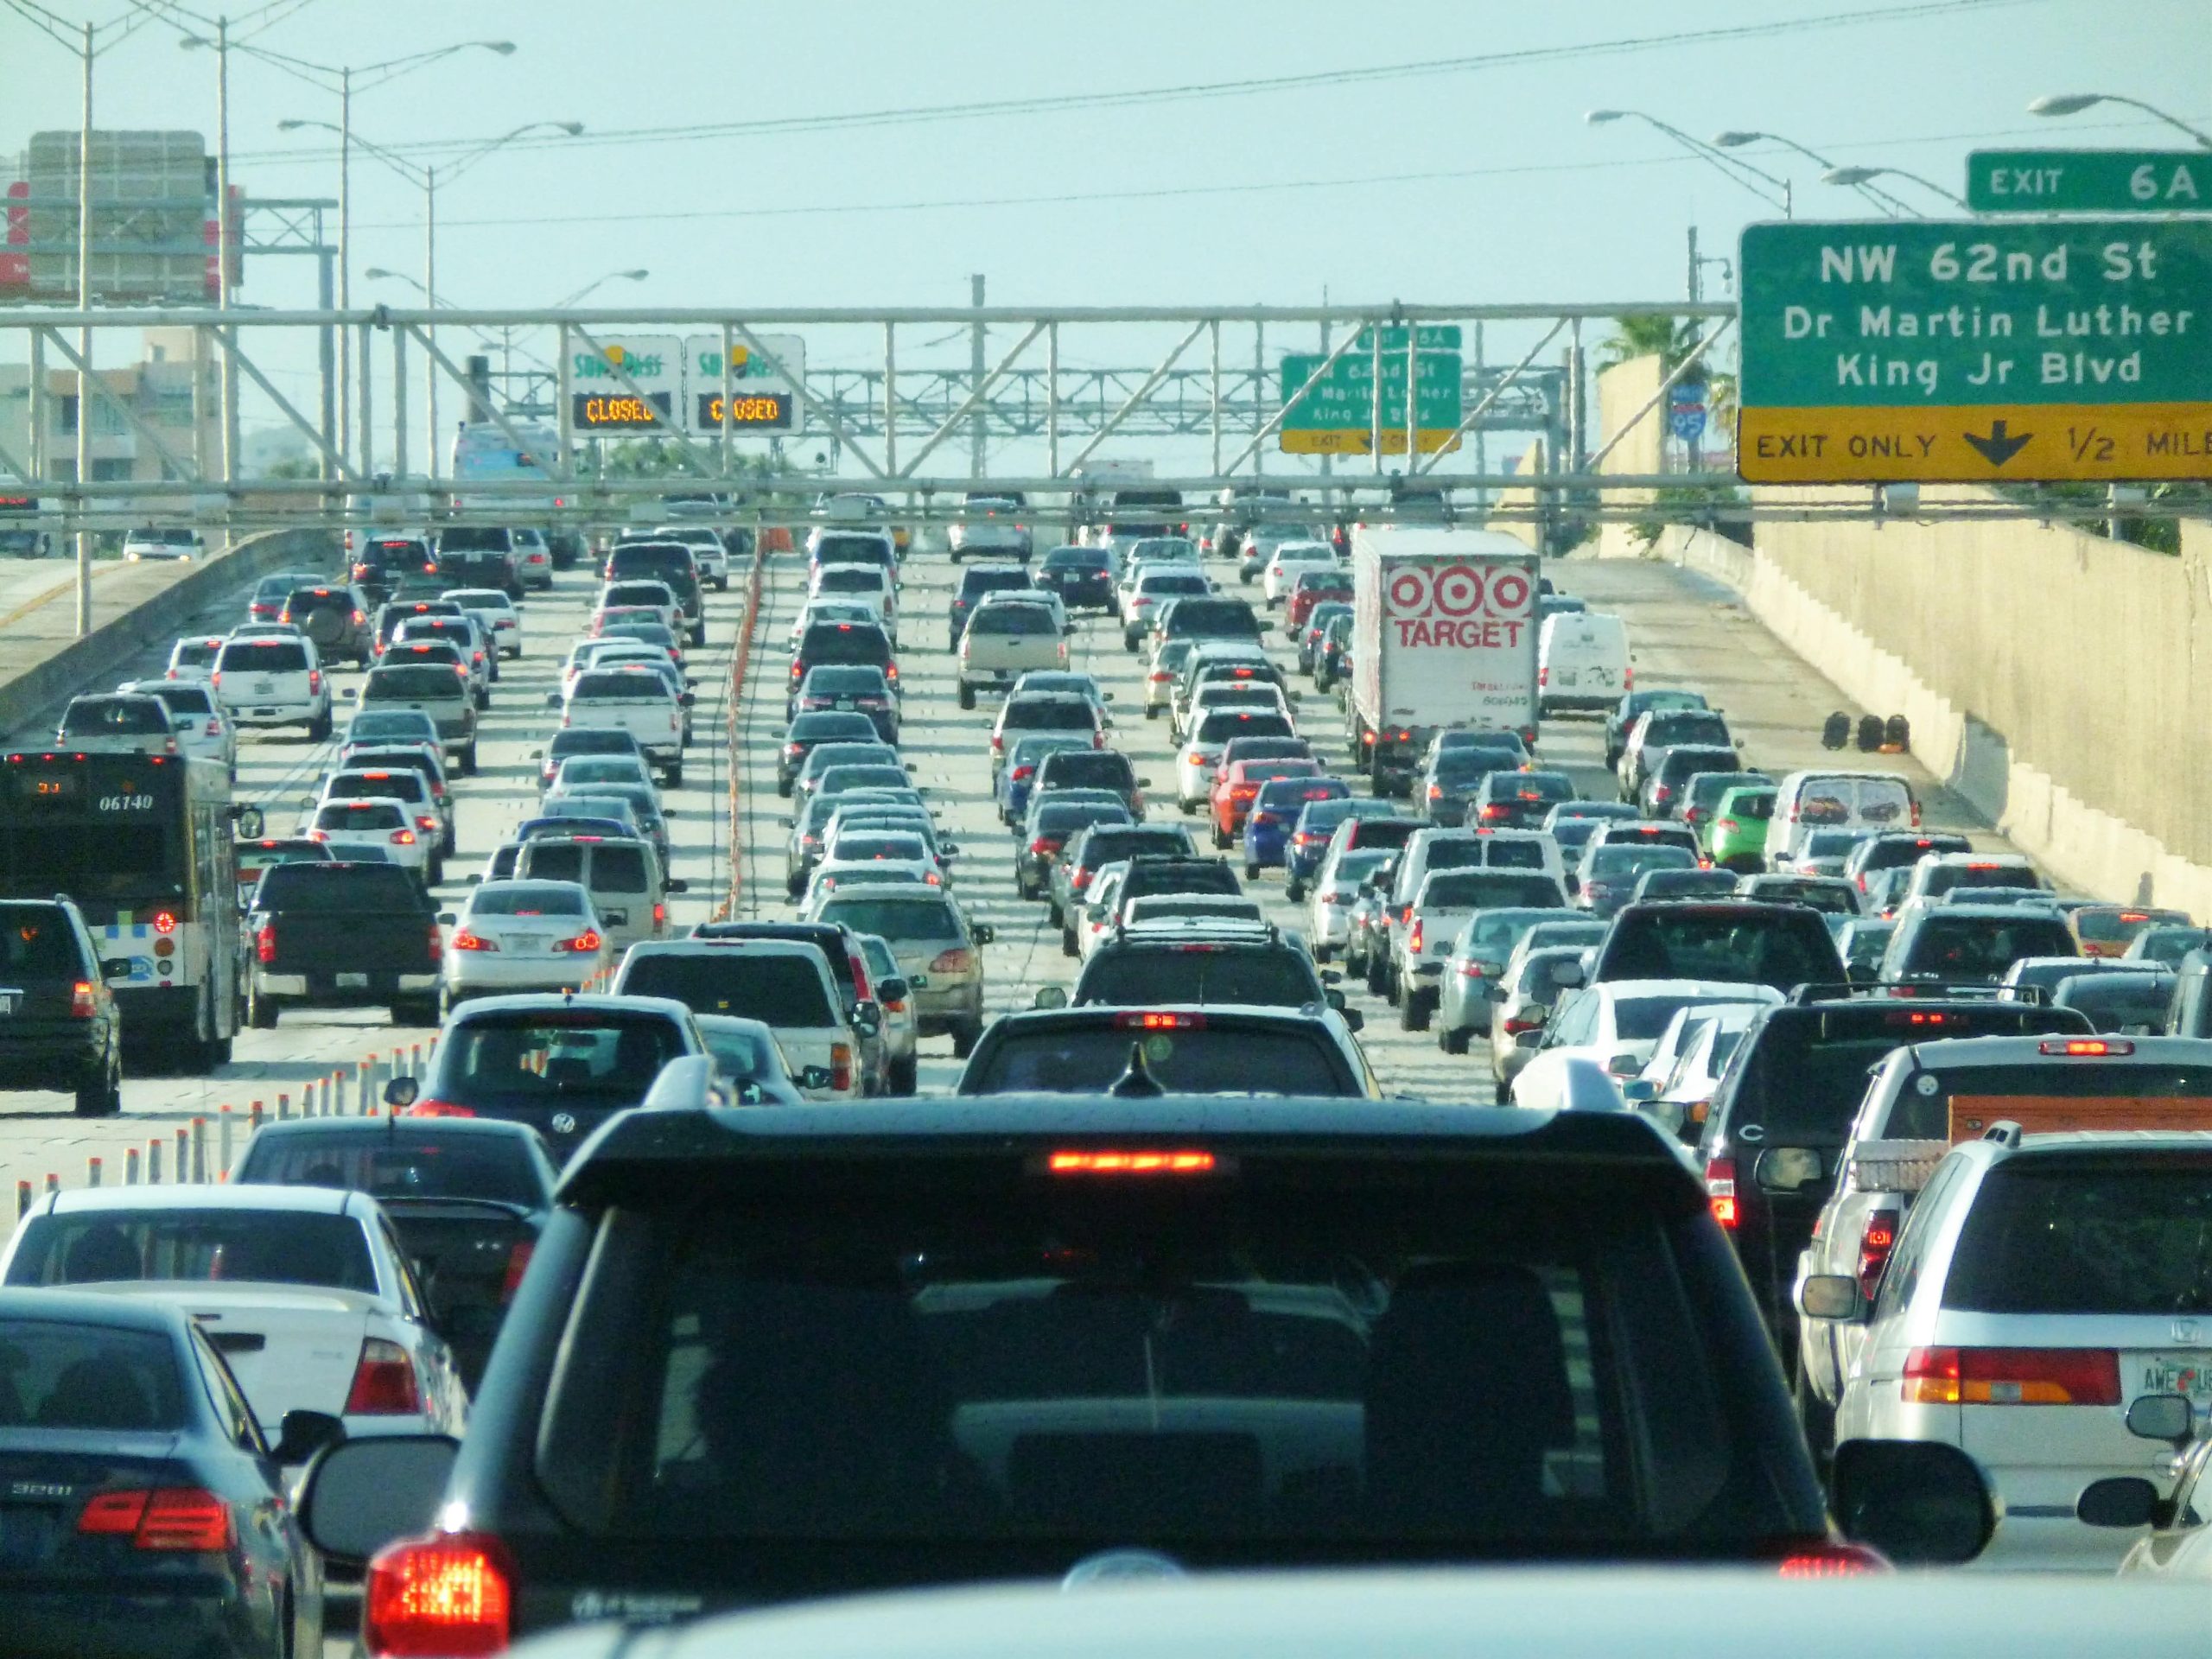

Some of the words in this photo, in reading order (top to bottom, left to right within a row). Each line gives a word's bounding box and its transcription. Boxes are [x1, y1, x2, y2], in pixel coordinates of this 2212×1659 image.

[1991, 168, 2063, 195] EXIT
[1821, 245, 1897, 283] NW
[1929, 243, 2067, 283] 62nd
[2102, 241, 2158, 281] St
[1784, 305, 1833, 340] Dr
[1860, 304, 2012, 338] Martin
[2037, 304, 2193, 337] Luther
[1837, 353, 1939, 396] King
[1967, 353, 2014, 385] Jr
[2041, 350, 2142, 385] Blvd
[709, 397, 779, 422] COSED
[1757, 434, 1828, 459] EXIT
[1848, 434, 1937, 459] ONLY
[1393, 620, 1524, 649] TARGET
